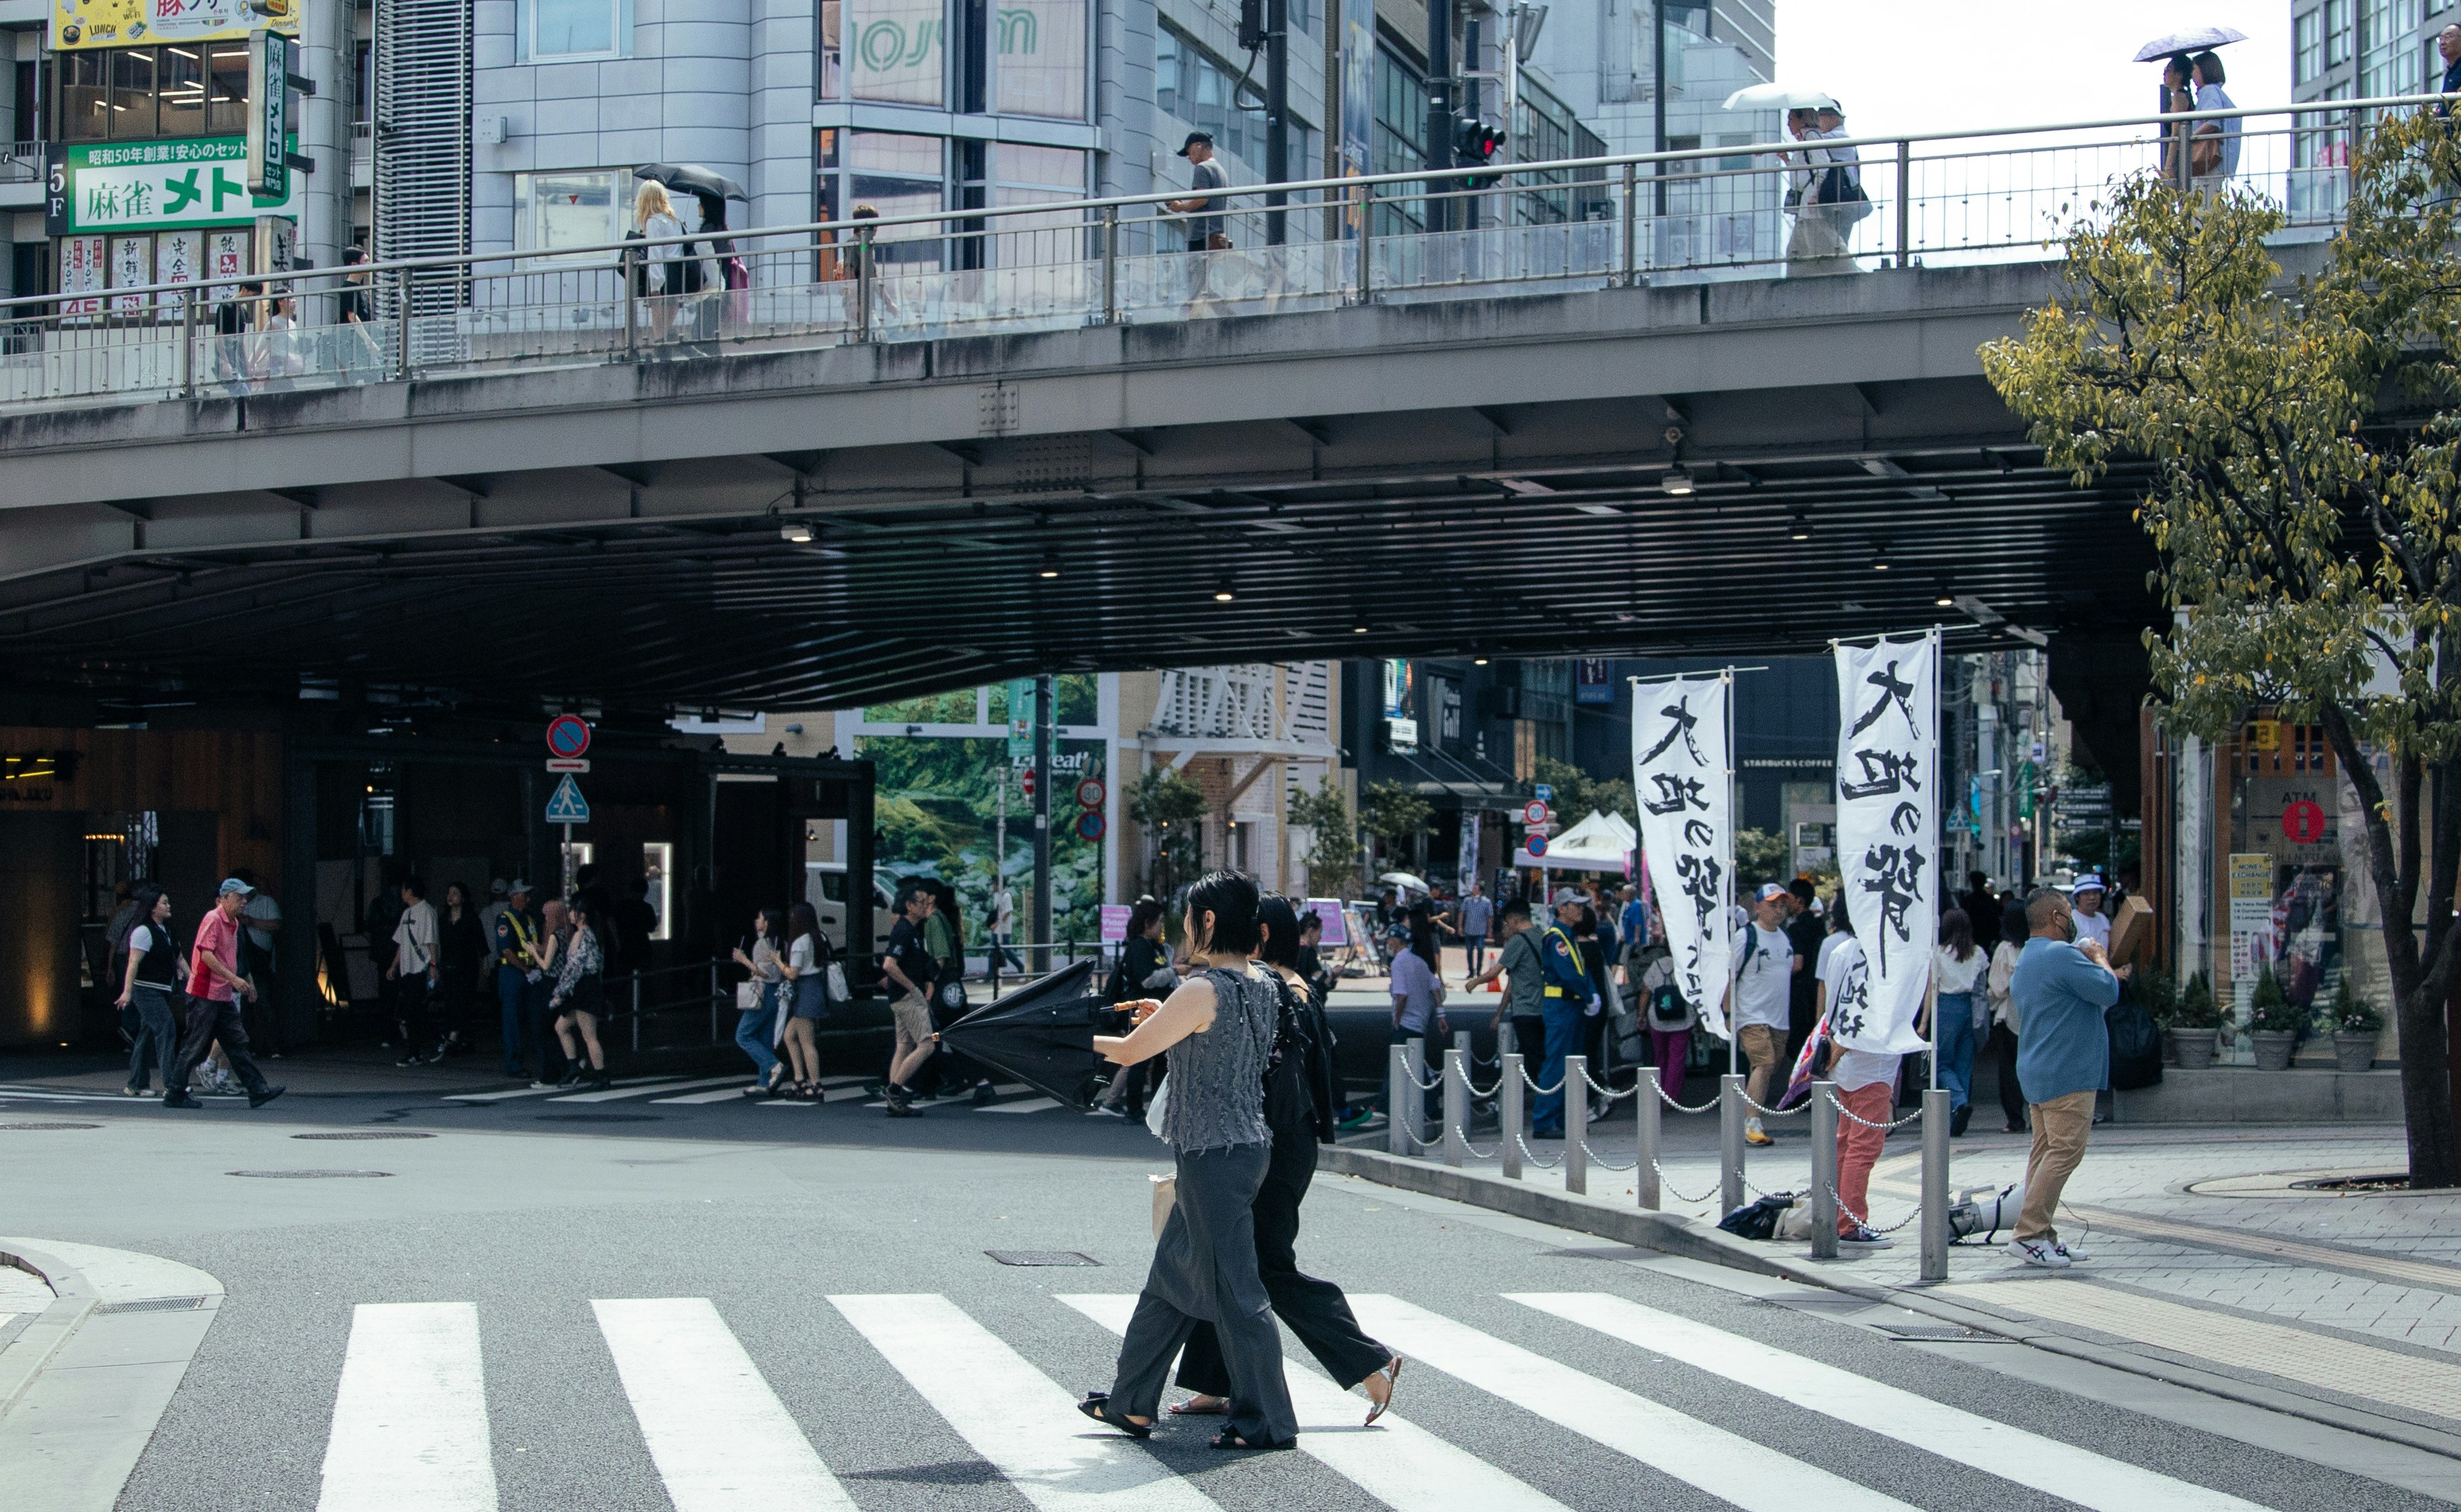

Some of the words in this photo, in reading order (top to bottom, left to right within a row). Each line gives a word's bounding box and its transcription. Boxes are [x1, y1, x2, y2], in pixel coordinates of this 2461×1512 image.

[90, 24, 116, 36] LUNCH
[1744, 759, 1797, 767] STARBUCKS
[1798, 759, 1833, 767] COFFEE
[2281, 792, 2316, 803] ATM
[1530, 808, 1544, 818] 20
